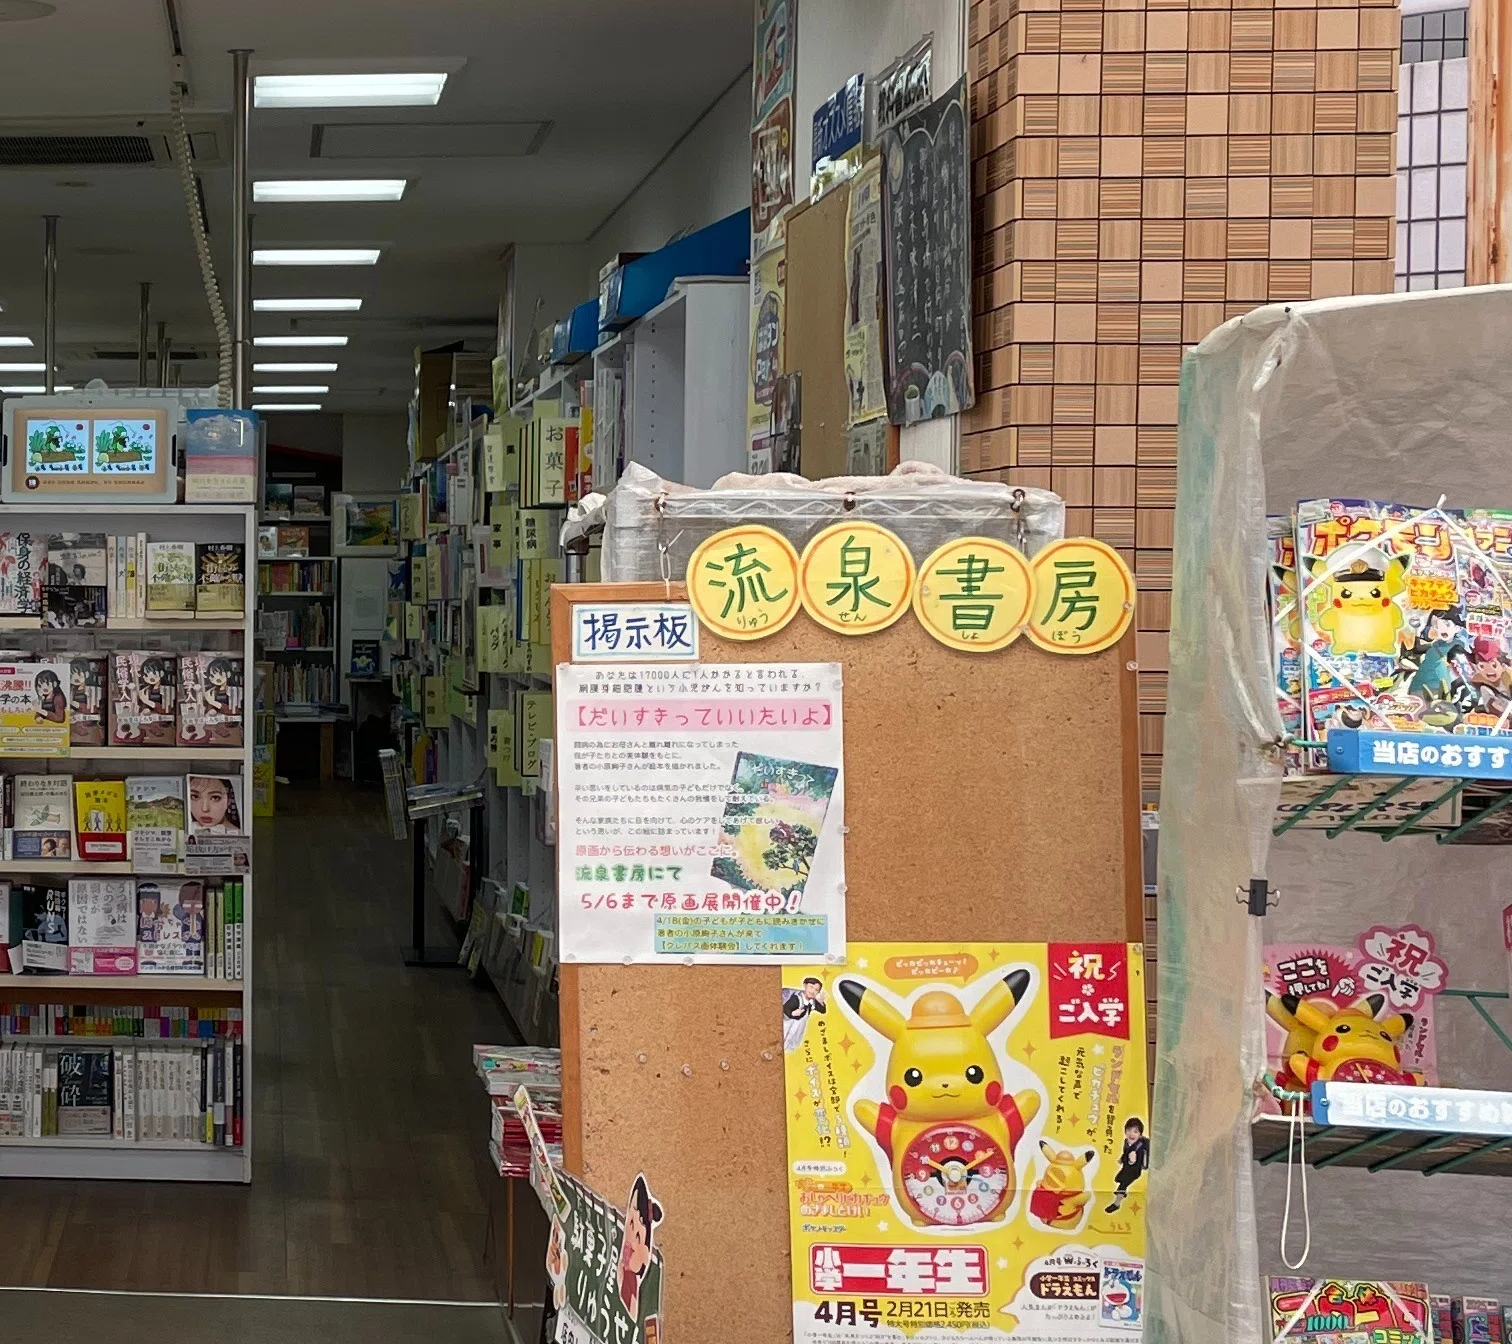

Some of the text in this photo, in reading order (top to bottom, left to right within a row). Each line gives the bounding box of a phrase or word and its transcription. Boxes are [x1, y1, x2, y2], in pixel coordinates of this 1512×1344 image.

[545, 425, 564, 497] お菓子
[705, 534, 1101, 631] 流泉書房
[584, 612, 692, 650] 掲示板
[736, 611, 770, 627] りゅう
[578, 704, 833, 728] 【だいすきっていいたいよ】
[575, 844, 739, 857] 原画から伝わる想いがここに。
[575, 863, 683, 882] 流泉書房にて
[580, 892, 802, 913] 5/6まで原画展開催中!
[1067, 950, 1106, 981] 祝
[1277, 957, 1329, 982] ここを
[1385, 933, 1429, 978] 祝
[1366, 965, 1419, 1000] ご入学
[1058, 997, 1125, 1027] ご入学
[814, 1246, 985, 1294] 小学一年生
[1040, 1283, 1098, 1297] ドラえもん
[813, 1298, 883, 1328] 4月号
[1306, 1314, 1350, 1332] 1000
